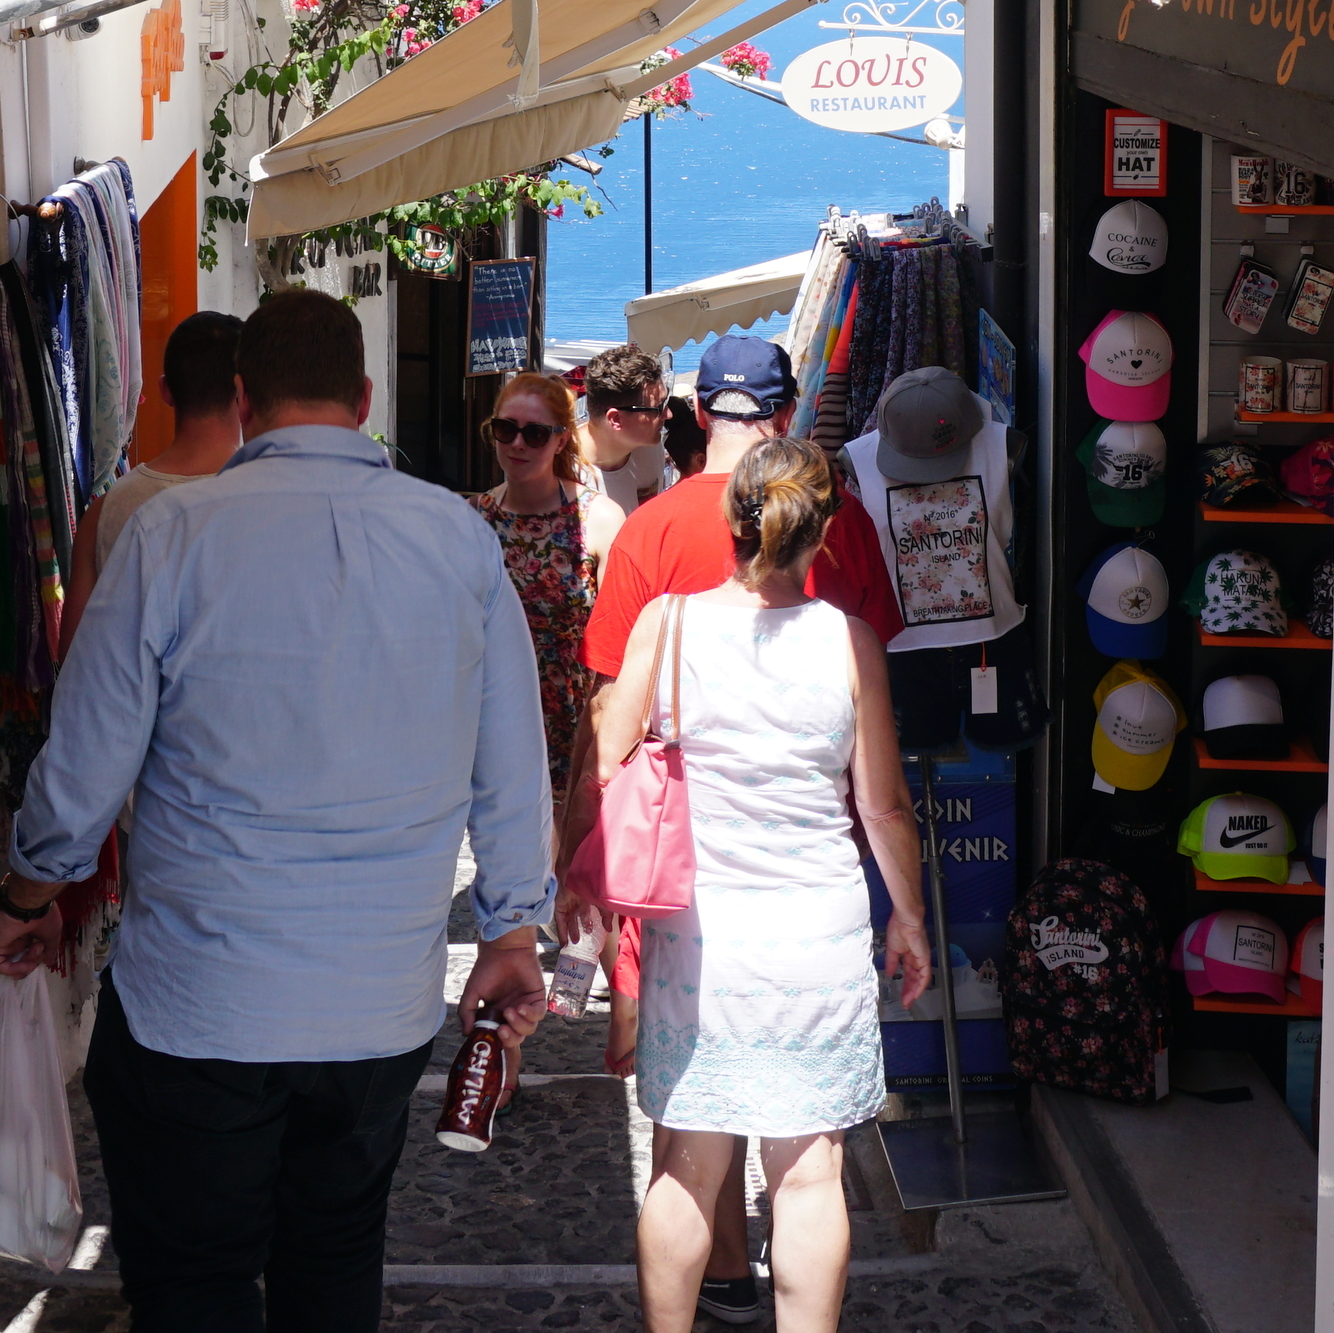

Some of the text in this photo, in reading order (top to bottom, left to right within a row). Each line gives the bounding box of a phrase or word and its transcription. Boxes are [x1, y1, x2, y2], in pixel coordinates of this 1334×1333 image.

[811, 53, 927, 89] LOUIS
[810, 94, 927, 112] RESTAURANT
[1113, 138, 1161, 150] CUSTOMIZE
[1117, 157, 1156, 172] HAT
[1285, 171, 1306, 194] 16
[1107, 233, 1158, 247] COCAINE
[352, 262, 382, 297] BAR
[1106, 348, 1162, 364] SANTORINI
[723, 373, 745, 382] POLO
[1123, 464, 1143, 481] 16
[899, 526, 983, 555] SANTORINI
[931, 552, 961, 564] ISLAND
[913, 604, 963, 618] BREATHTAKING
[1228, 815, 1268, 832] NAKED
[1029, 915, 1102, 950] Santorini
[1046, 949, 1085, 964] ISLAND
[1073, 963, 1099, 981] #16
[895, 1077, 933, 1085] SANTORINI
[972, 1075, 994, 1083] COINS
